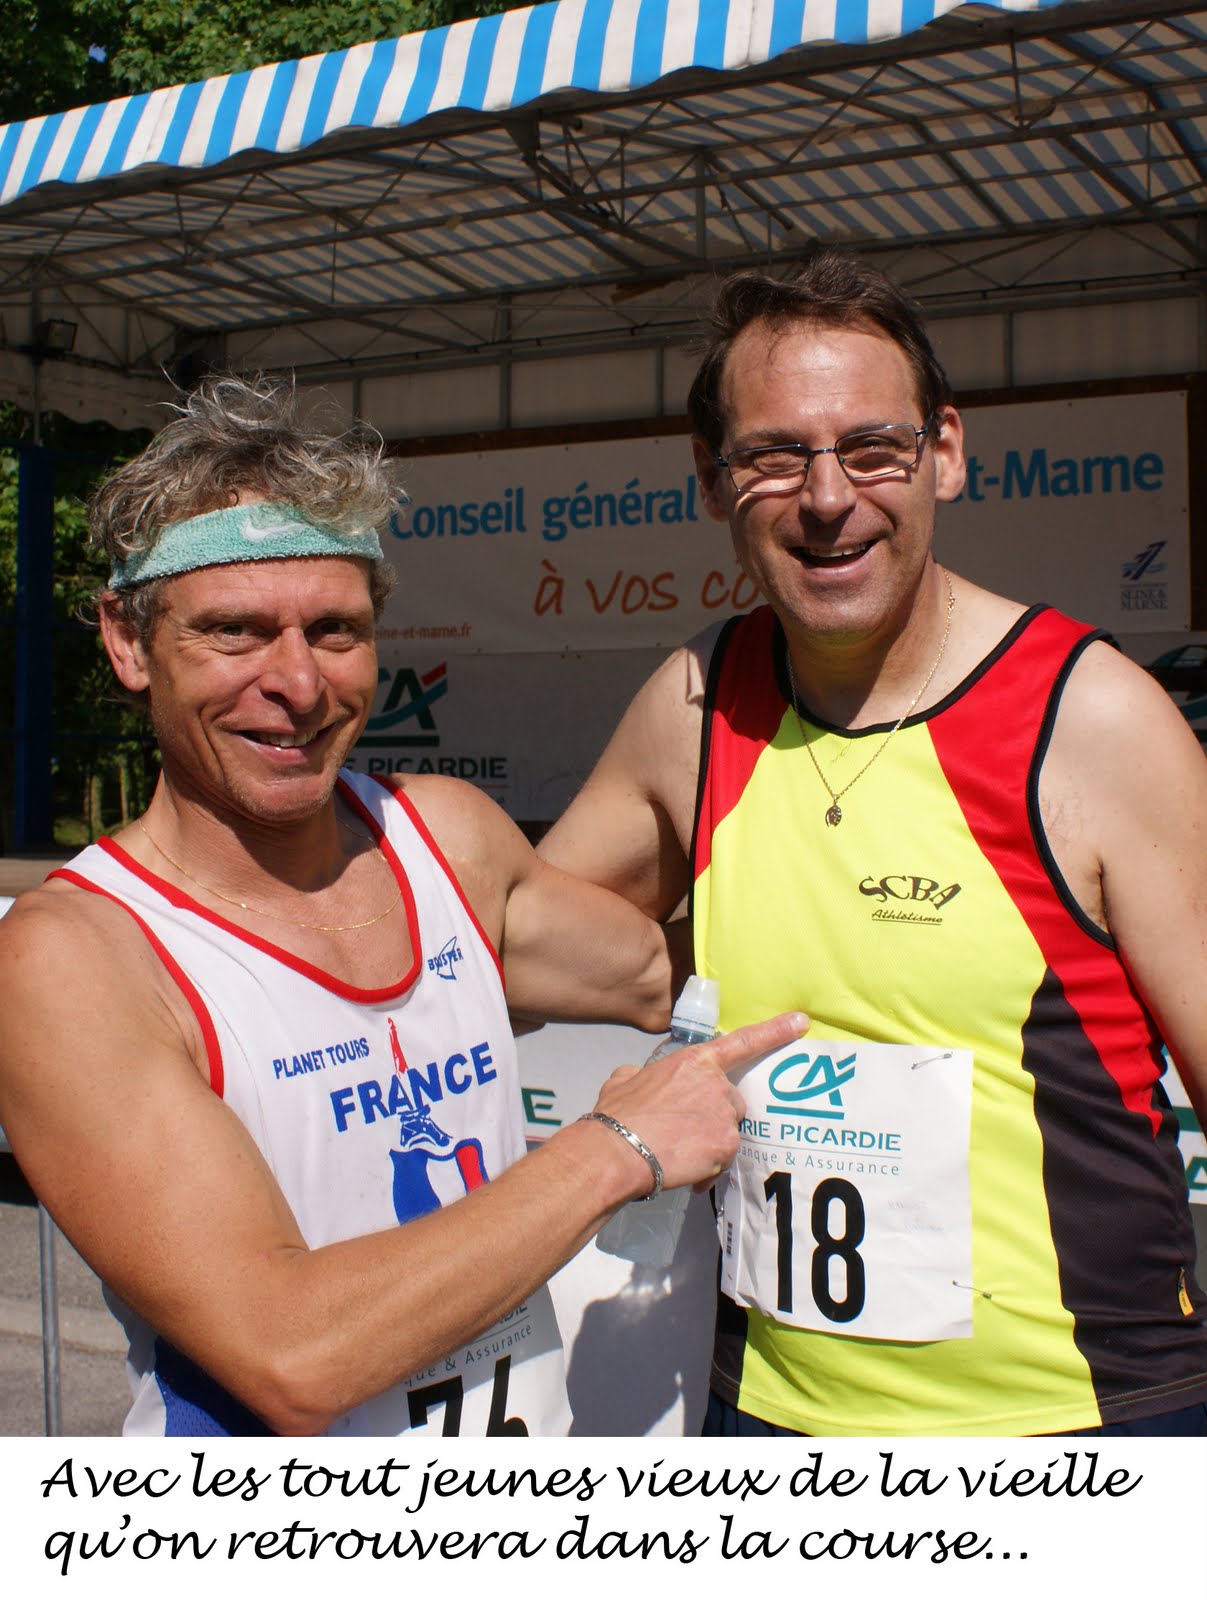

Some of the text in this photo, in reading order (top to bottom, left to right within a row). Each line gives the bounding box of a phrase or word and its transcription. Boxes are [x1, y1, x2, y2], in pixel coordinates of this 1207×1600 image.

[389, 447, 1165, 541] Conseil général t-Marne
[533, 558, 565, 616] à
[585, 569, 679, 615] vos
[368, 756, 508, 779] PICARDIE
[858, 875, 962, 911] SCBA
[427, 947, 464, 971] BOOSTER
[272, 1037, 370, 1079] PLANET TOURS
[329, 1041, 498, 1133] FRANCE
[780, 1124, 902, 1151] PICARDIE
[785, 1152, 796, 1165] &
[804, 1154, 900, 1176] Assurance
[763, 1170, 866, 1324] 18
[465, 1323, 532, 1365] Assurance
